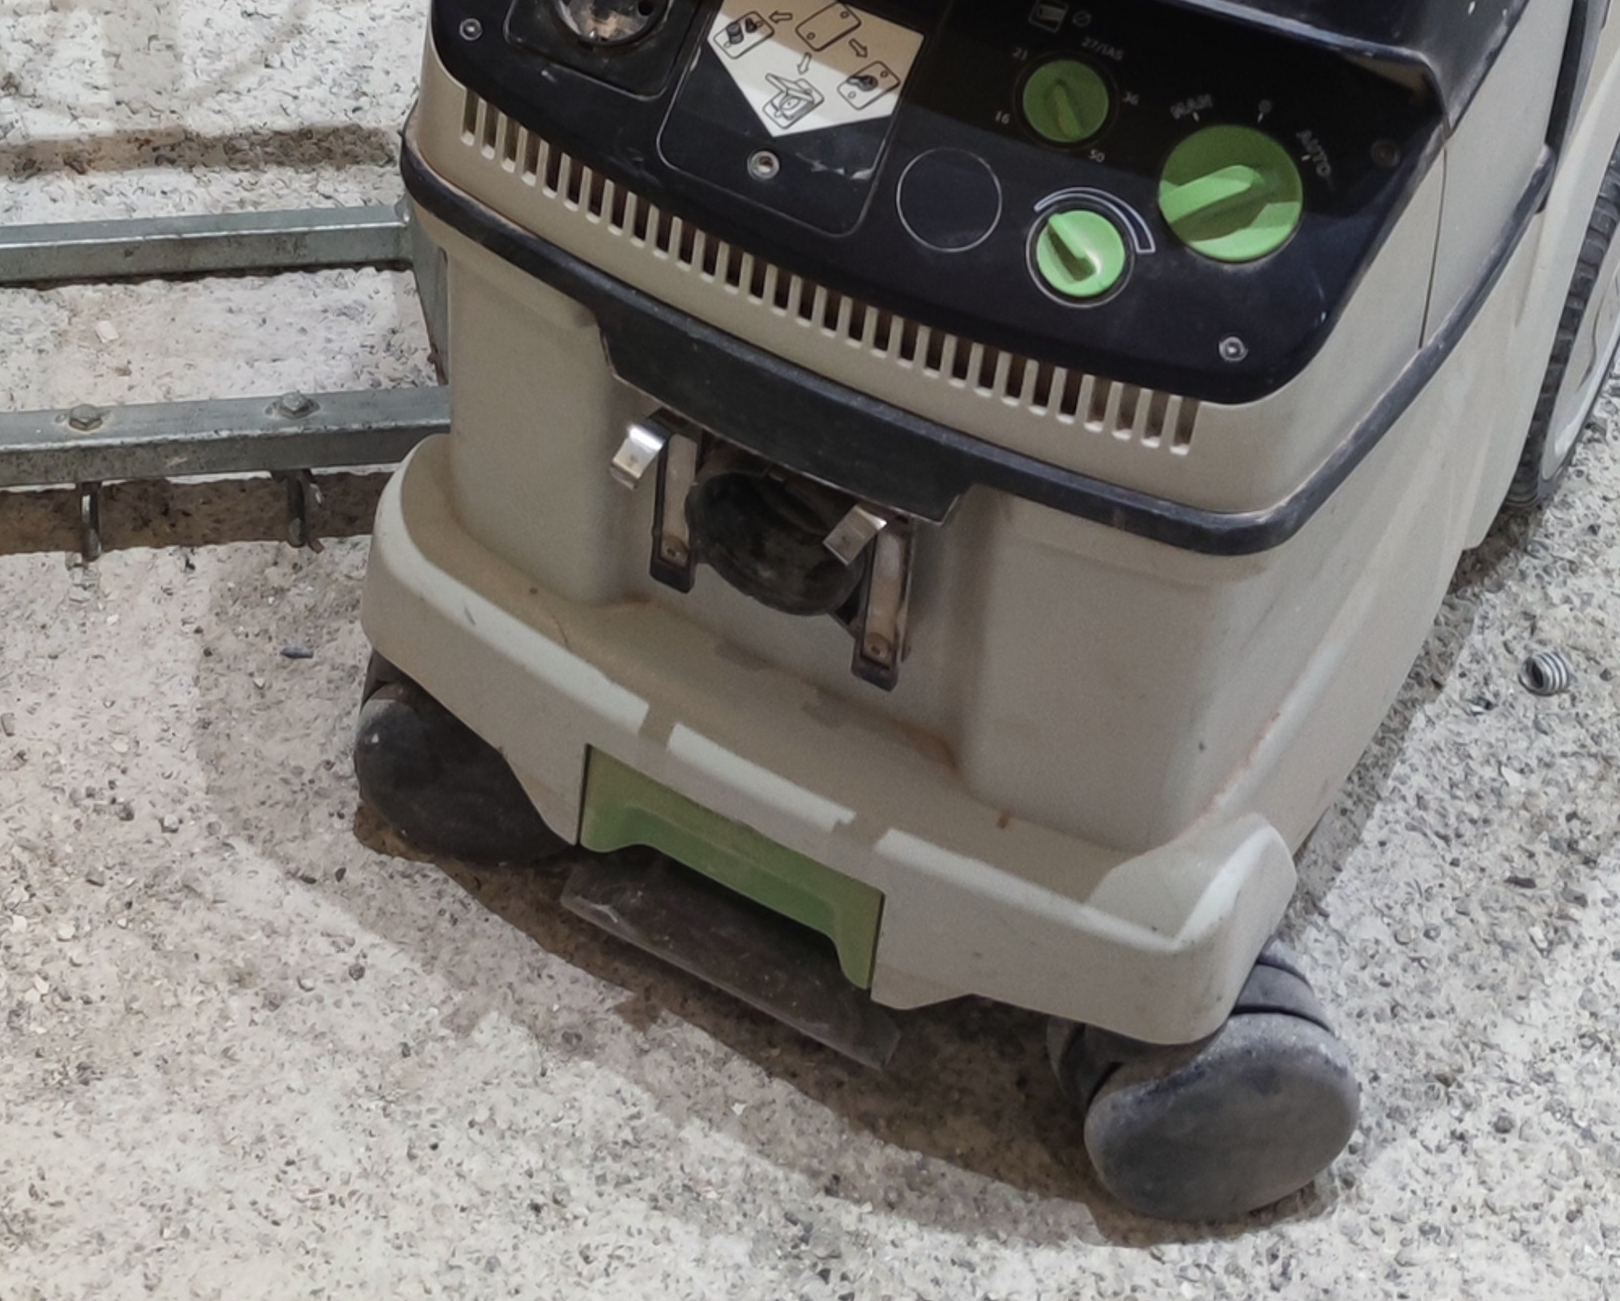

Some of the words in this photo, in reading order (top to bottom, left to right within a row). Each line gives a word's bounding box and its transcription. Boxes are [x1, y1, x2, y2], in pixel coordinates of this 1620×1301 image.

[1012, 46, 1029, 62] 21
[1122, 90, 1140, 107] 36
[994, 109, 1011, 125] 16
[1088, 149, 1106, 164] 50
[1296, 130, 1332, 178] AUTO
